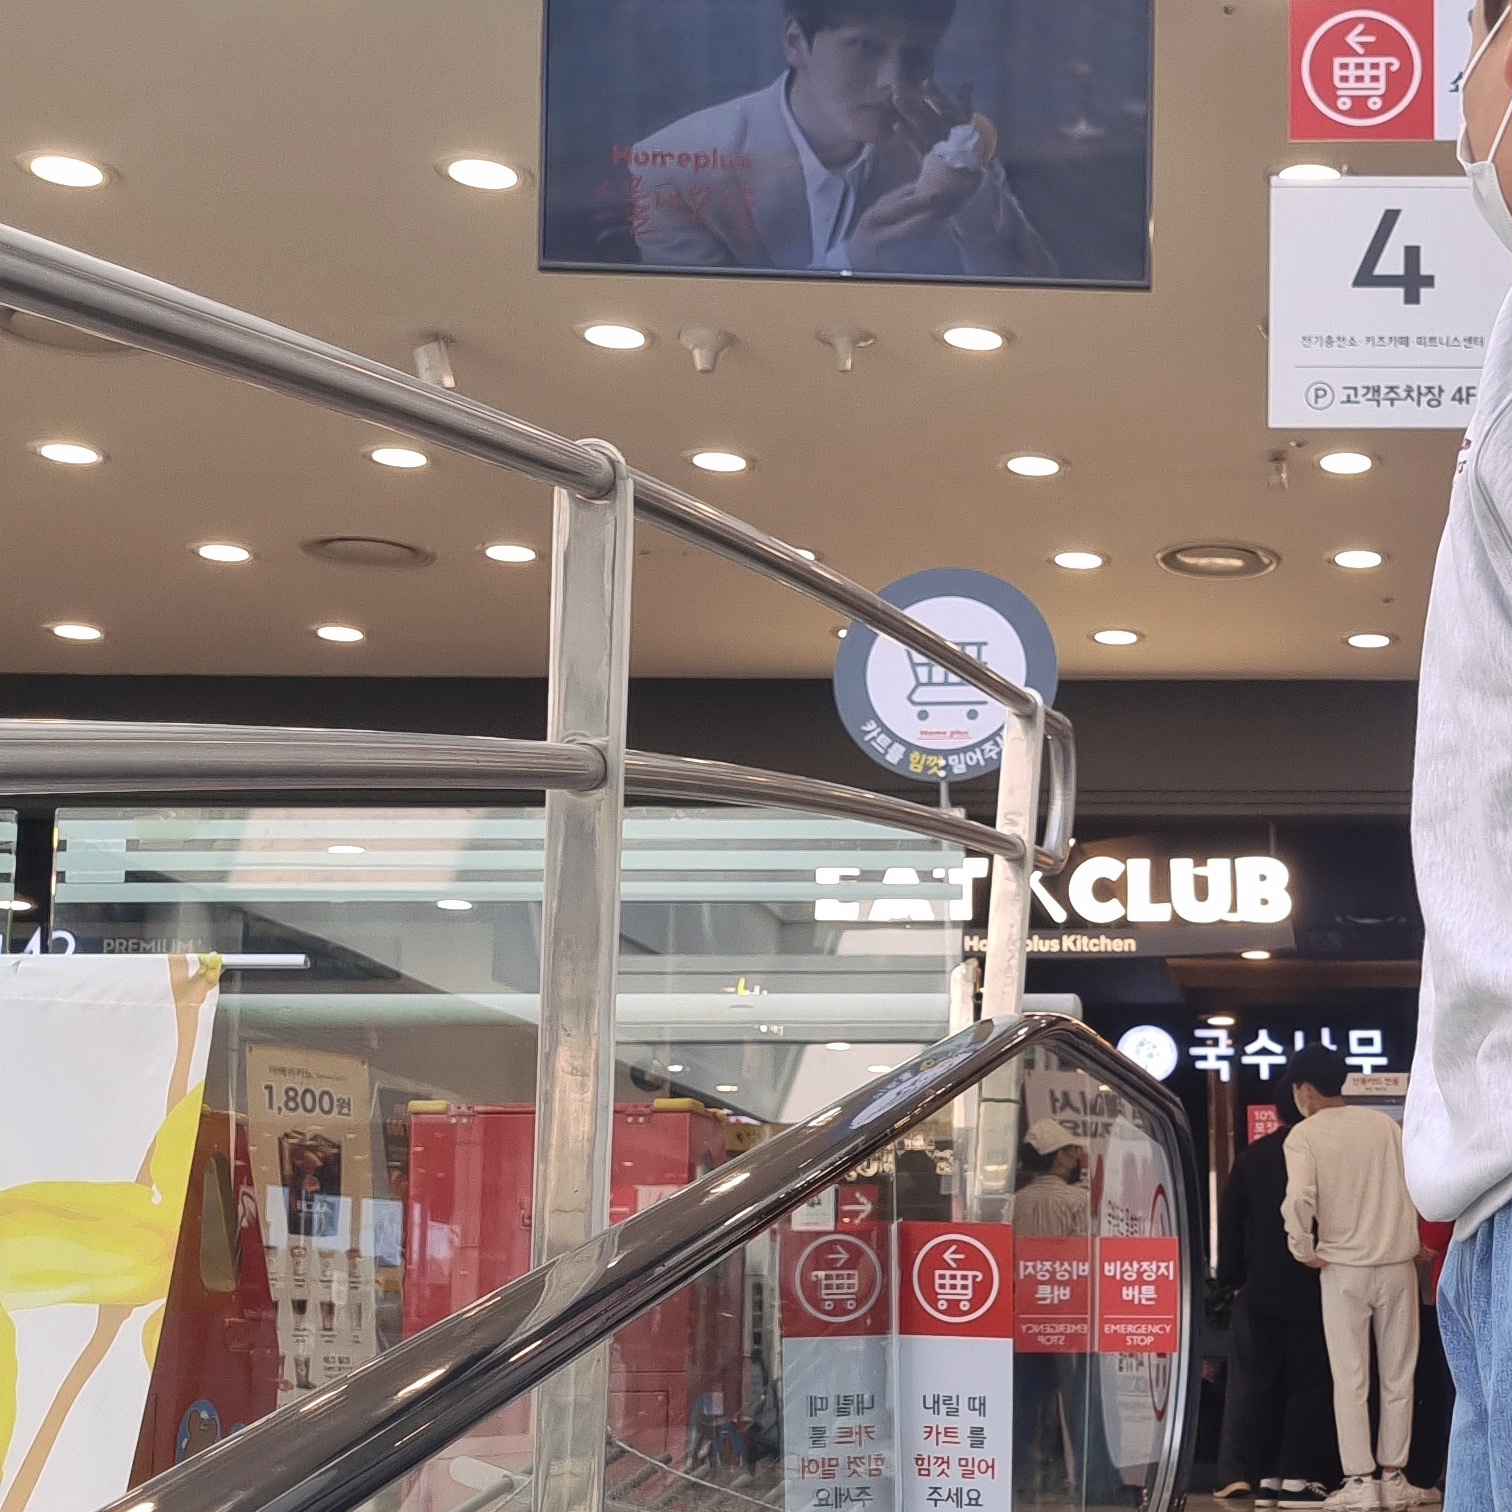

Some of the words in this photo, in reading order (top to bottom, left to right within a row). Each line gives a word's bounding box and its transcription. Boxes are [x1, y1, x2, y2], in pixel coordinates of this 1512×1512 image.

[1352, 208, 1435, 305] 4
[1340, 384, 1445, 408] 고객주차장
[1450, 385, 1477, 406] 4F
[860, 719, 906, 765] 카트를
[909, 751, 947, 776] 힘껏
[1068, 855, 1292, 924] CLUB
[1062, 934, 1137, 952] Kitchen
[263, 1083, 351, 1117] 1,800원
[1104, 1259, 1174, 1281] 비상정지
[1122, 1285, 1157, 1305] 버튼
[1104, 1324, 1172, 1335] EMERGENCY
[1126, 1335, 1154, 1346] STOP
[922, 1393, 960, 1417] 내릴
[967, 1395, 988, 1418] 때
[922, 1424, 961, 1446] 카트
[967, 1426, 988, 1449] 를
[914, 1453, 951, 1479] 힘껏
[957, 1456, 996, 1480] 밀어
[926, 1486, 984, 1510] 주세요
